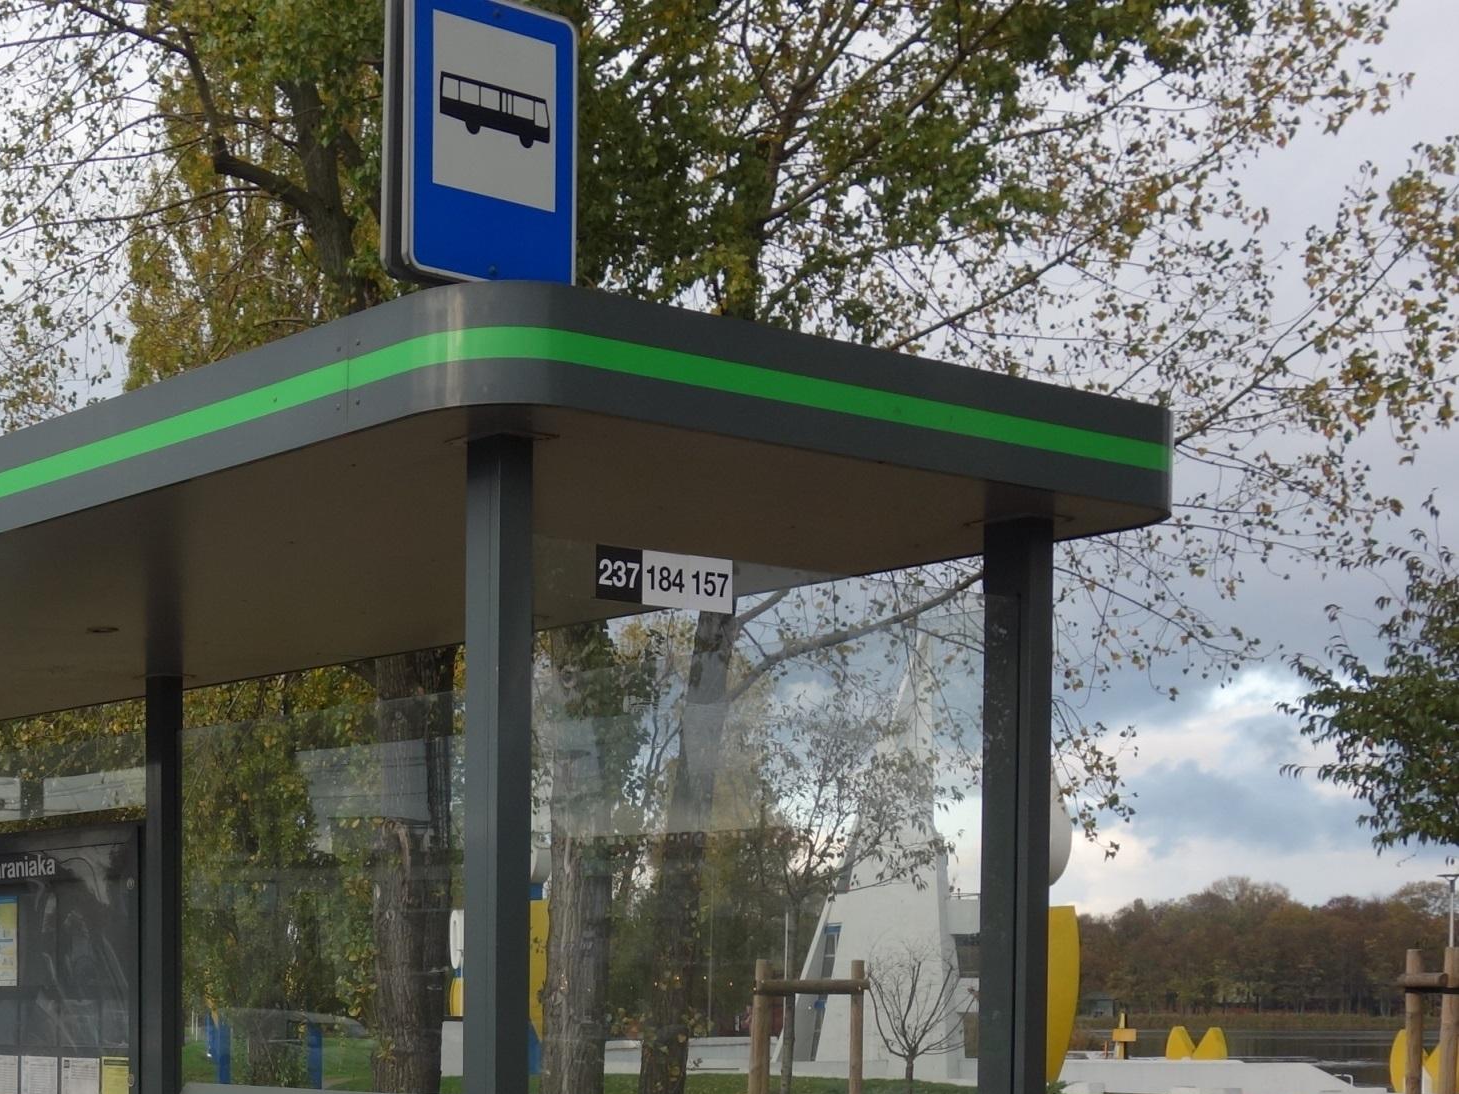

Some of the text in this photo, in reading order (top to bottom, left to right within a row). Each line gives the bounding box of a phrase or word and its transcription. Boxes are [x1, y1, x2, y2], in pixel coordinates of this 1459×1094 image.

[598, 558, 729, 598] 237 184 157
